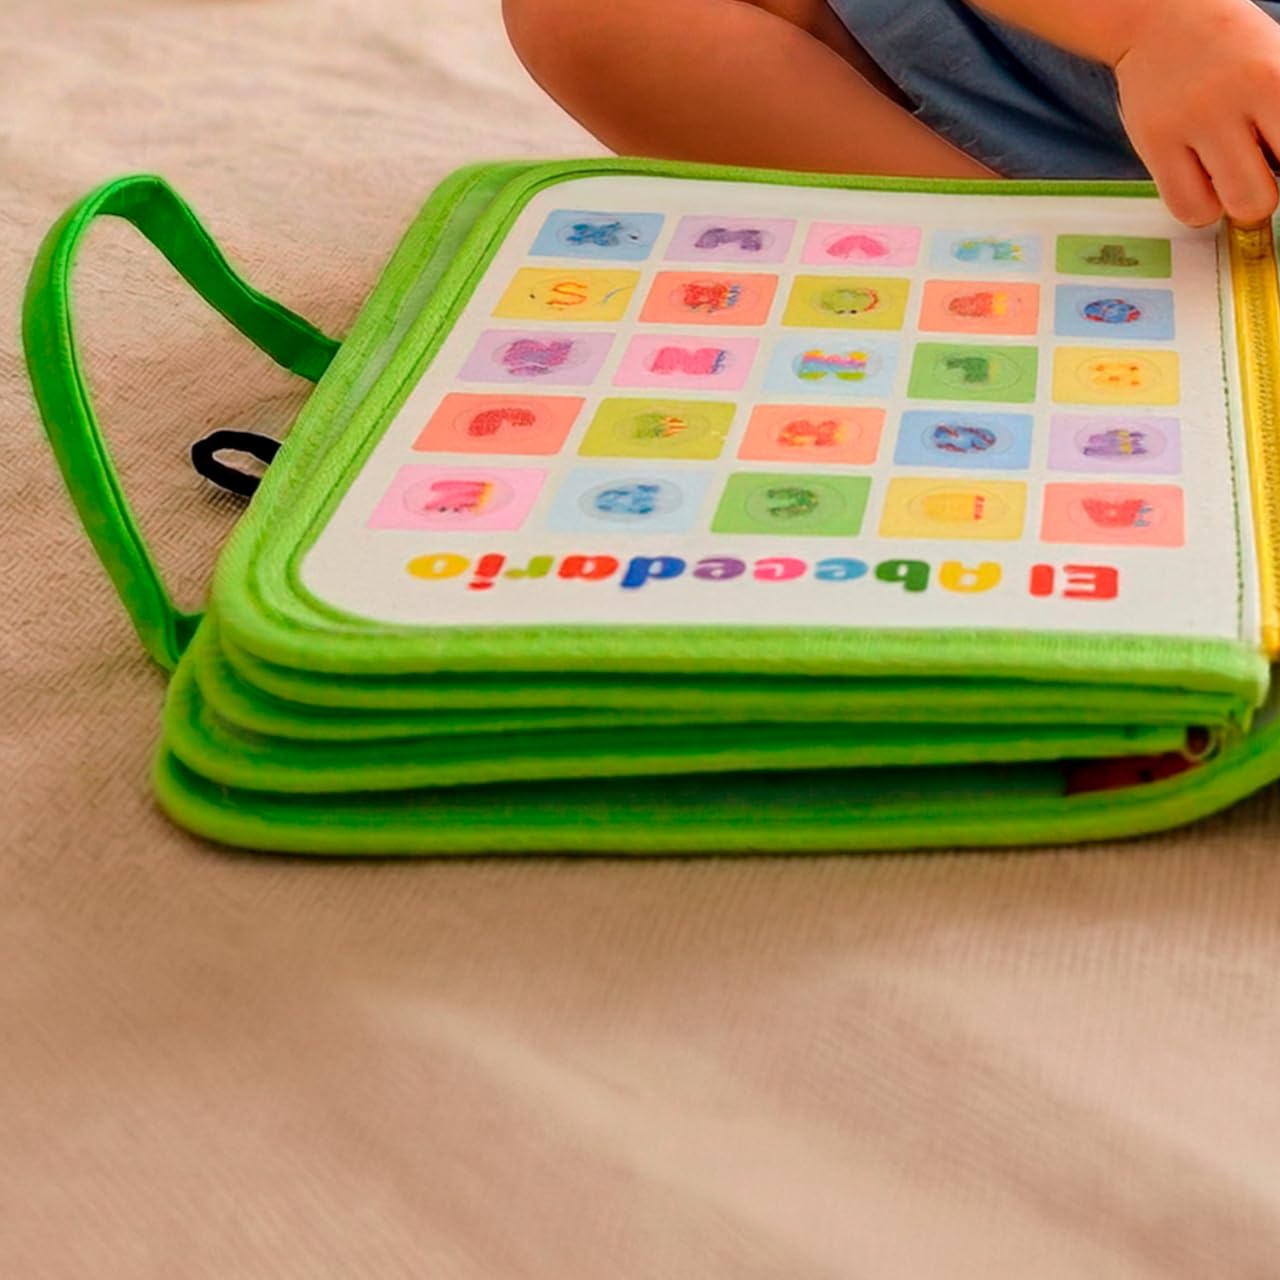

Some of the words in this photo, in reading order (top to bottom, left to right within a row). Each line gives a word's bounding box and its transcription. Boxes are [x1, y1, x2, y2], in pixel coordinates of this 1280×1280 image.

[826, 235, 888, 259] V
[1083, 245, 1138, 267] T
[548, 282, 587, 309] S
[467, 408, 536, 438] J
[1082, 499, 1143, 528] A
[407, 554, 1001, 593] Abecedario
[1028, 564, 1119, 600] El
